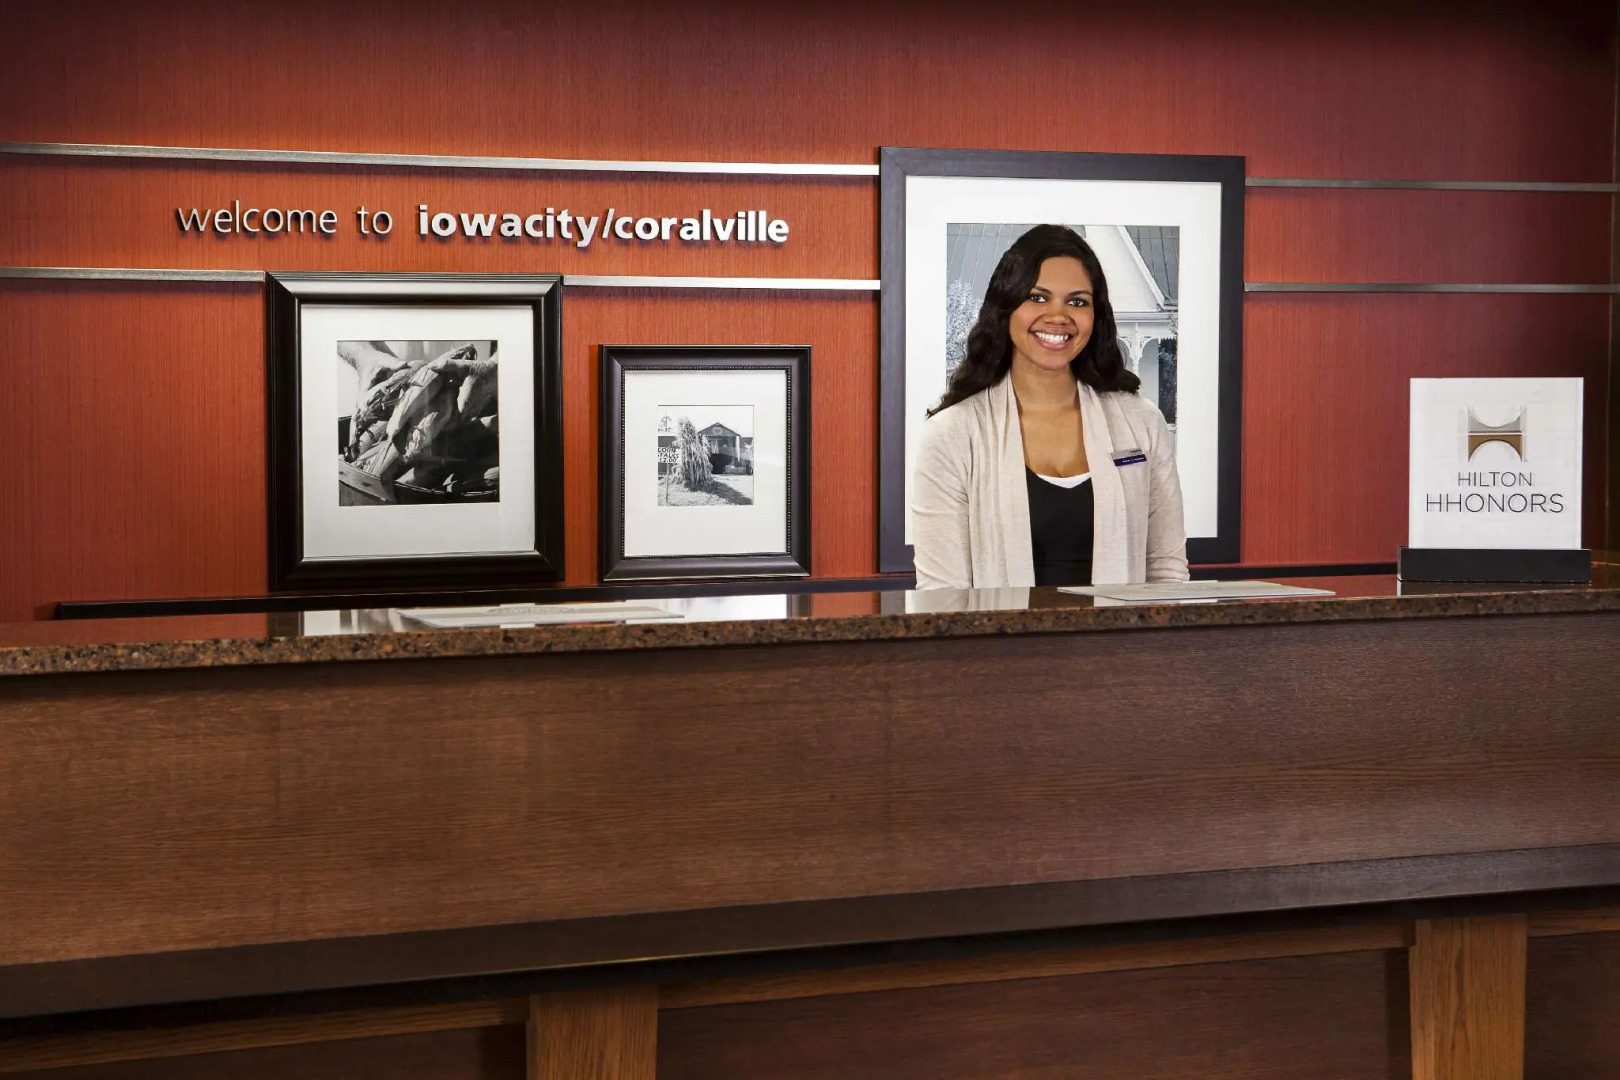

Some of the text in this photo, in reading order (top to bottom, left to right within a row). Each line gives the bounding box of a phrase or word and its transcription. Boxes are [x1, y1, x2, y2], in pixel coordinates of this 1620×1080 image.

[177, 199, 790, 248] welcome to iowacity/coralville
[1457, 471, 1533, 487] HILTON
[1426, 493, 1564, 513] HHONORS
